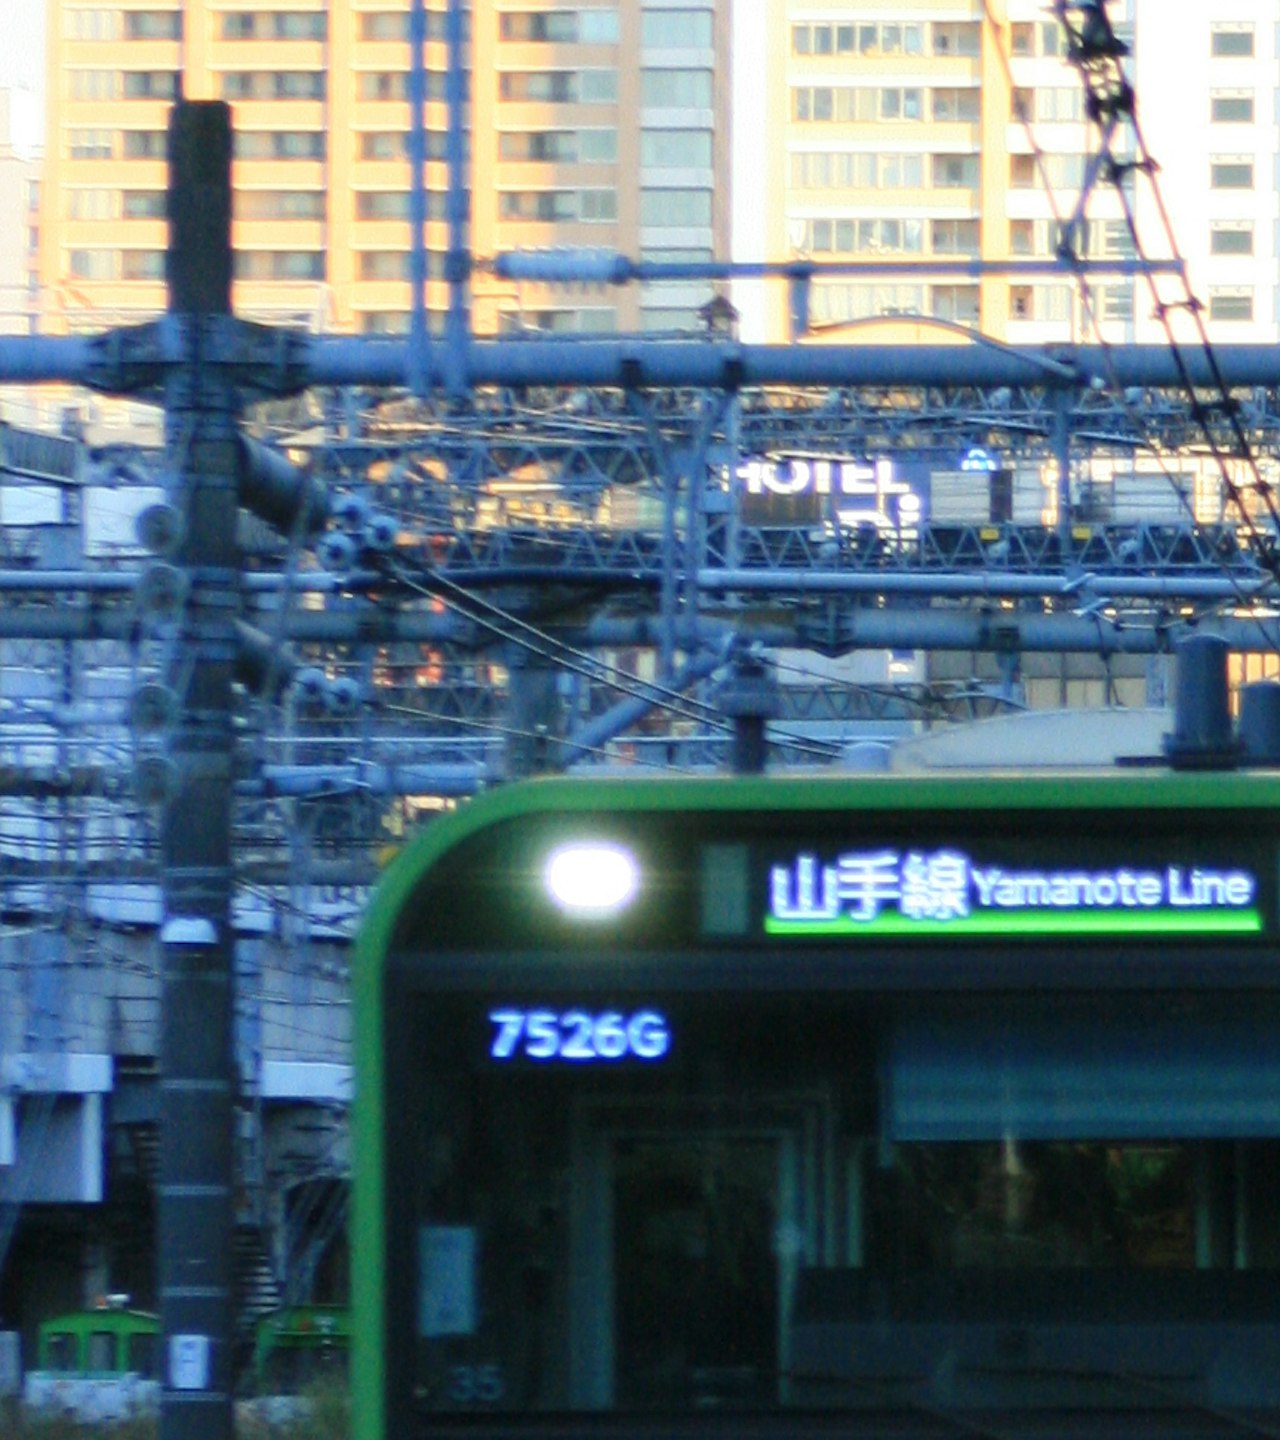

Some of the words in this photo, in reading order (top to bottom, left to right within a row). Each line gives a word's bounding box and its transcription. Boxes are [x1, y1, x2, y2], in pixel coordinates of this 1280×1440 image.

[735, 459, 911, 494] HOTEL
[771, 851, 970, 921] 山手線
[971, 867, 1161, 907] Yamanote
[1166, 864, 1253, 906] Line
[488, 1011, 669, 1058] 7526G
